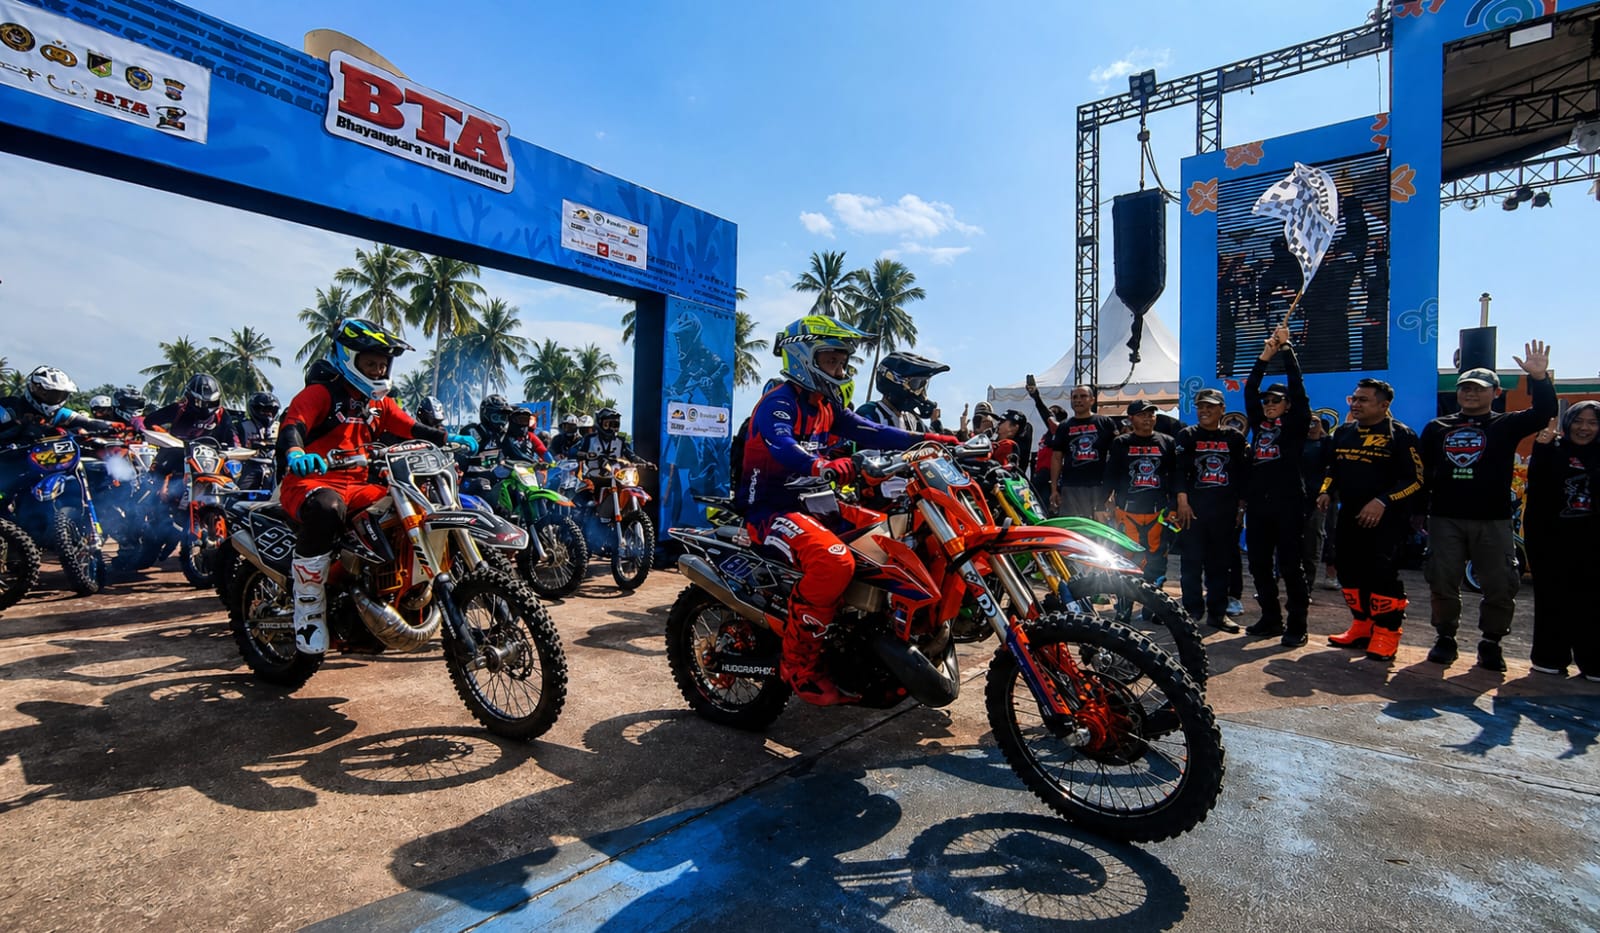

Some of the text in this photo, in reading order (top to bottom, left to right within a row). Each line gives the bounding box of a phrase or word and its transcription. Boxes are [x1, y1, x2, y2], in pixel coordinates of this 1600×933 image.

[94, 88, 150, 116] BTA
[338, 61, 508, 172] BTA
[336, 115, 507, 185] Bhayangkara Trail Adventure
